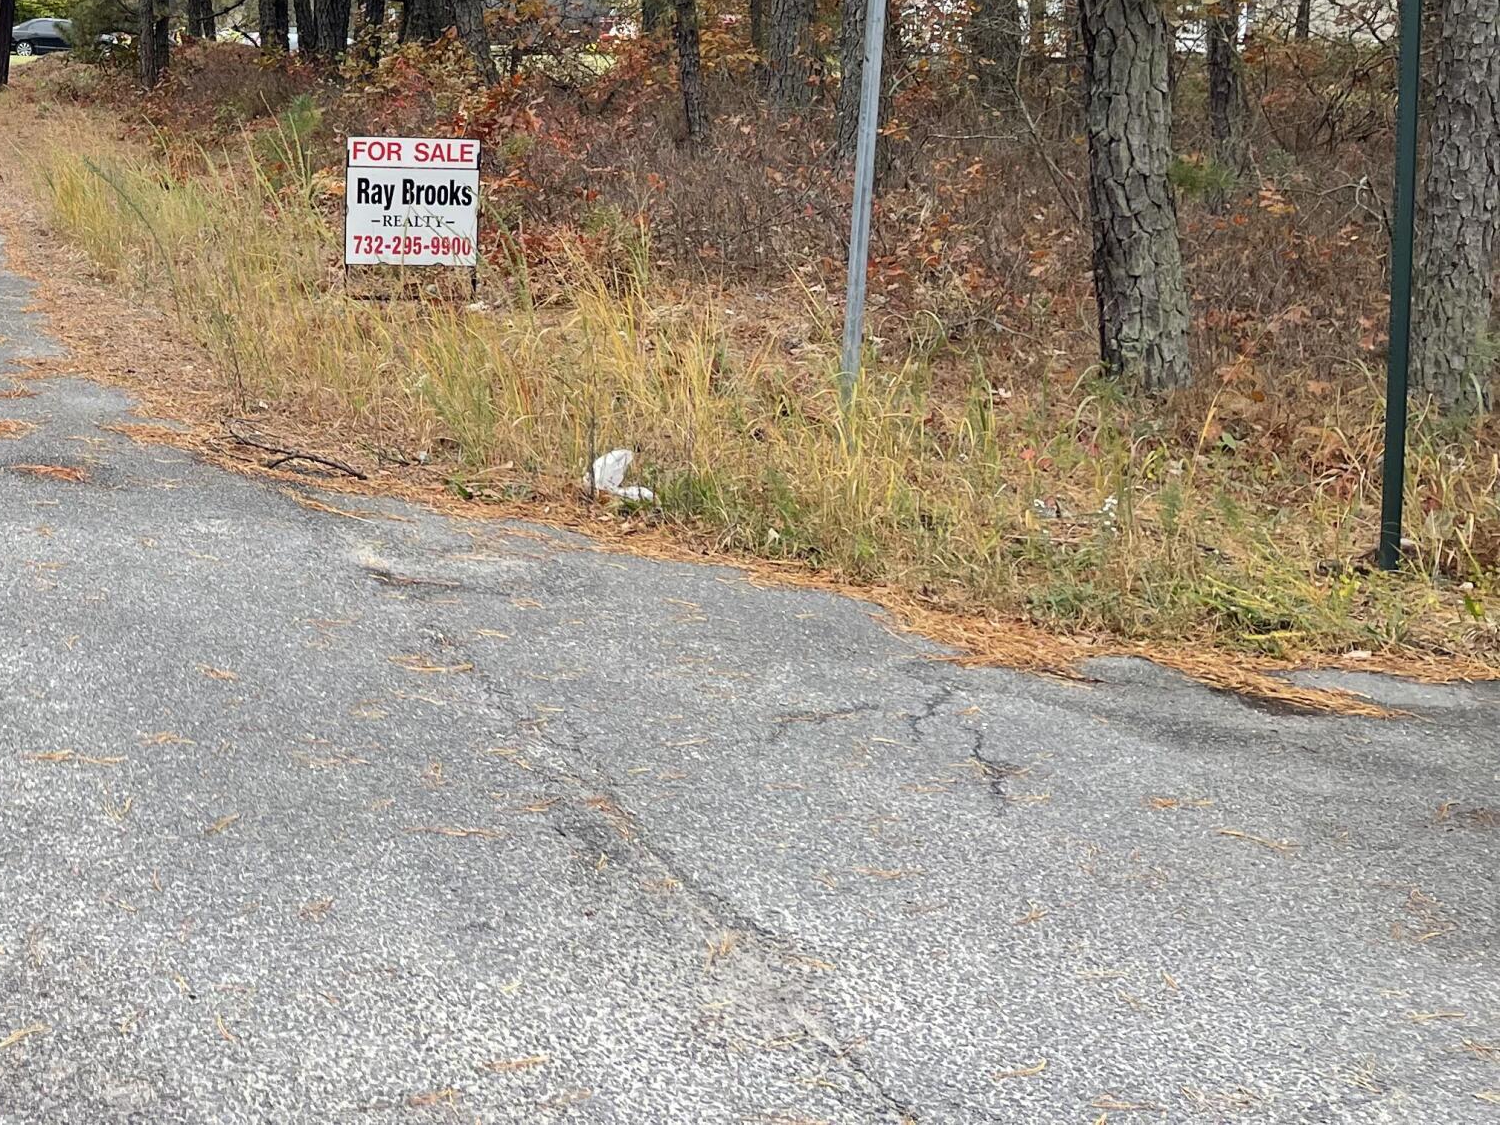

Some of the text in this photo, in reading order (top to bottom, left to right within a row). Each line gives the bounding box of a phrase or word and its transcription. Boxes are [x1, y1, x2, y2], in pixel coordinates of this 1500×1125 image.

[352, 141, 474, 163] FOR SALE
[356, 177, 472, 211] Ray Brooks
[353, 235, 471, 255] 732-295-9900
